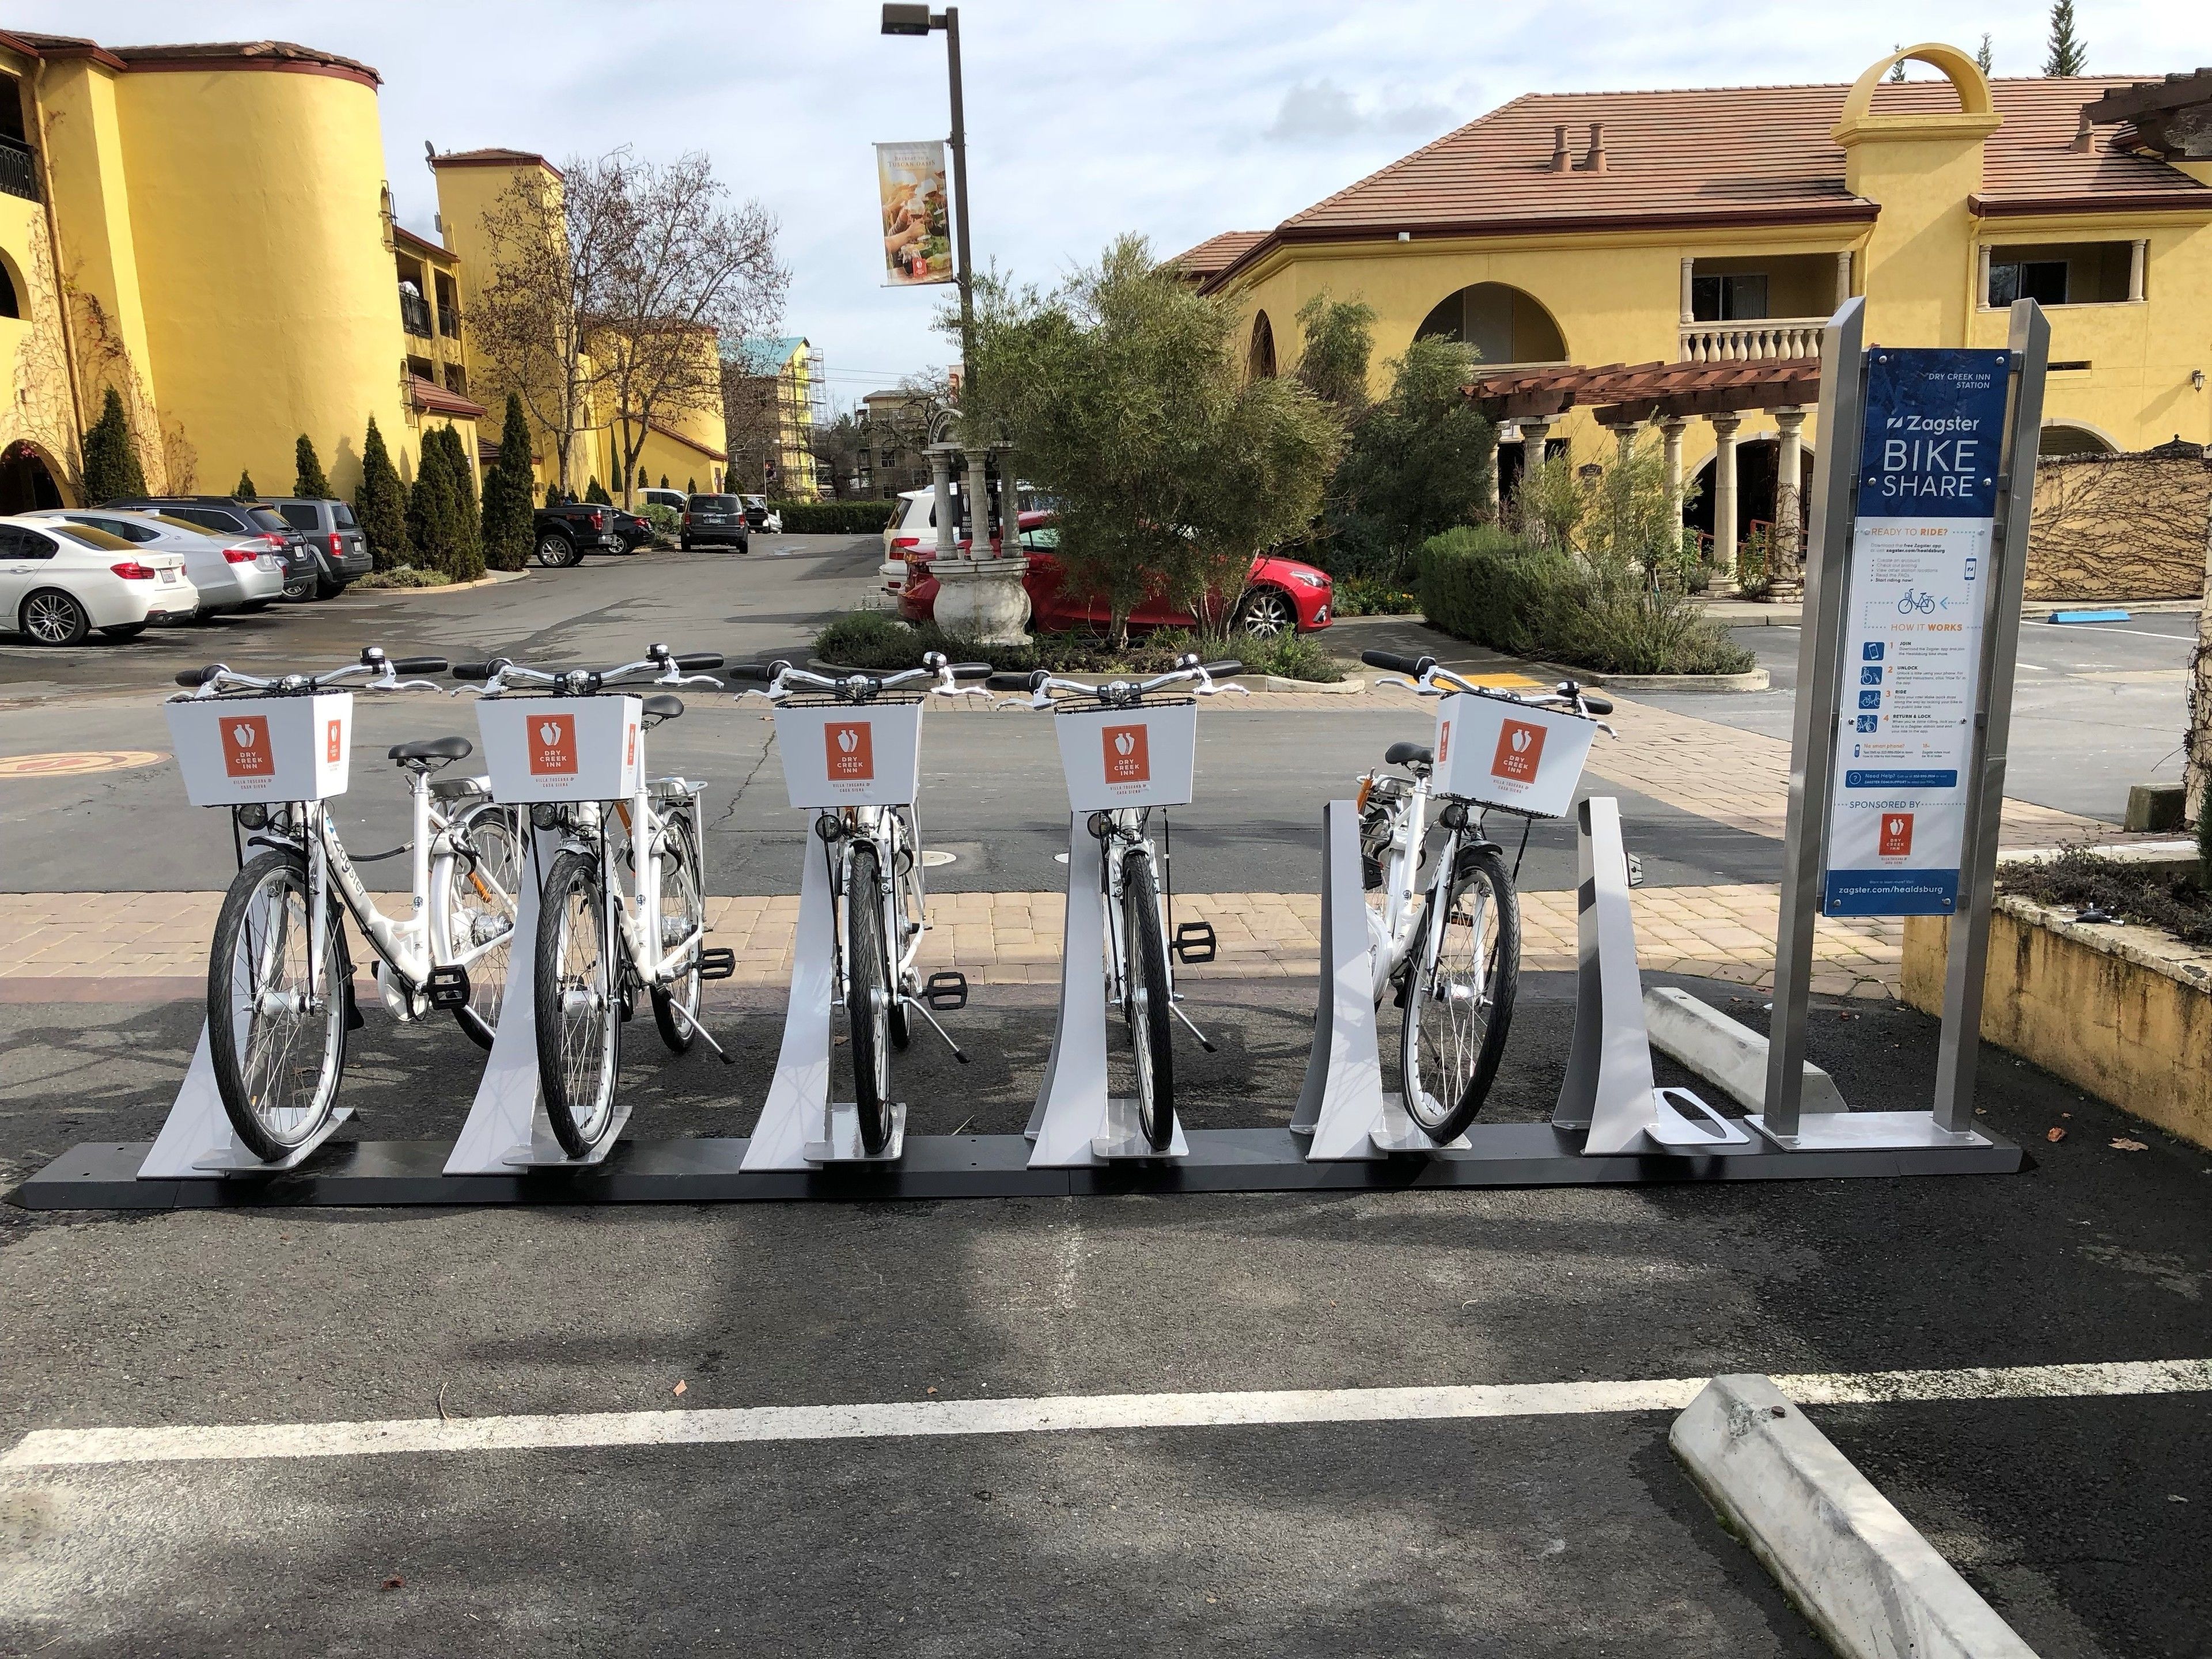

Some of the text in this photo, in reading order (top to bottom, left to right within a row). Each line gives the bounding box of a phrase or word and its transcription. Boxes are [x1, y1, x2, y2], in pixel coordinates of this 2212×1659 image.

[1907, 415, 1980, 435] Zagster
[1883, 440, 1979, 472] BIKE
[1881, 475, 1975, 497] SHARE
[1890, 641, 1893, 649] 1
[1888, 665, 1893, 673] 2
[1503, 760, 1529, 770] CREEK
[1507, 766, 1522, 774] INN
[1849, 801, 1921, 809] SPONSORED BY
[332, 840, 365, 897] Zagster
[1838, 886, 1943, 895] zagster.com/healdsburg
